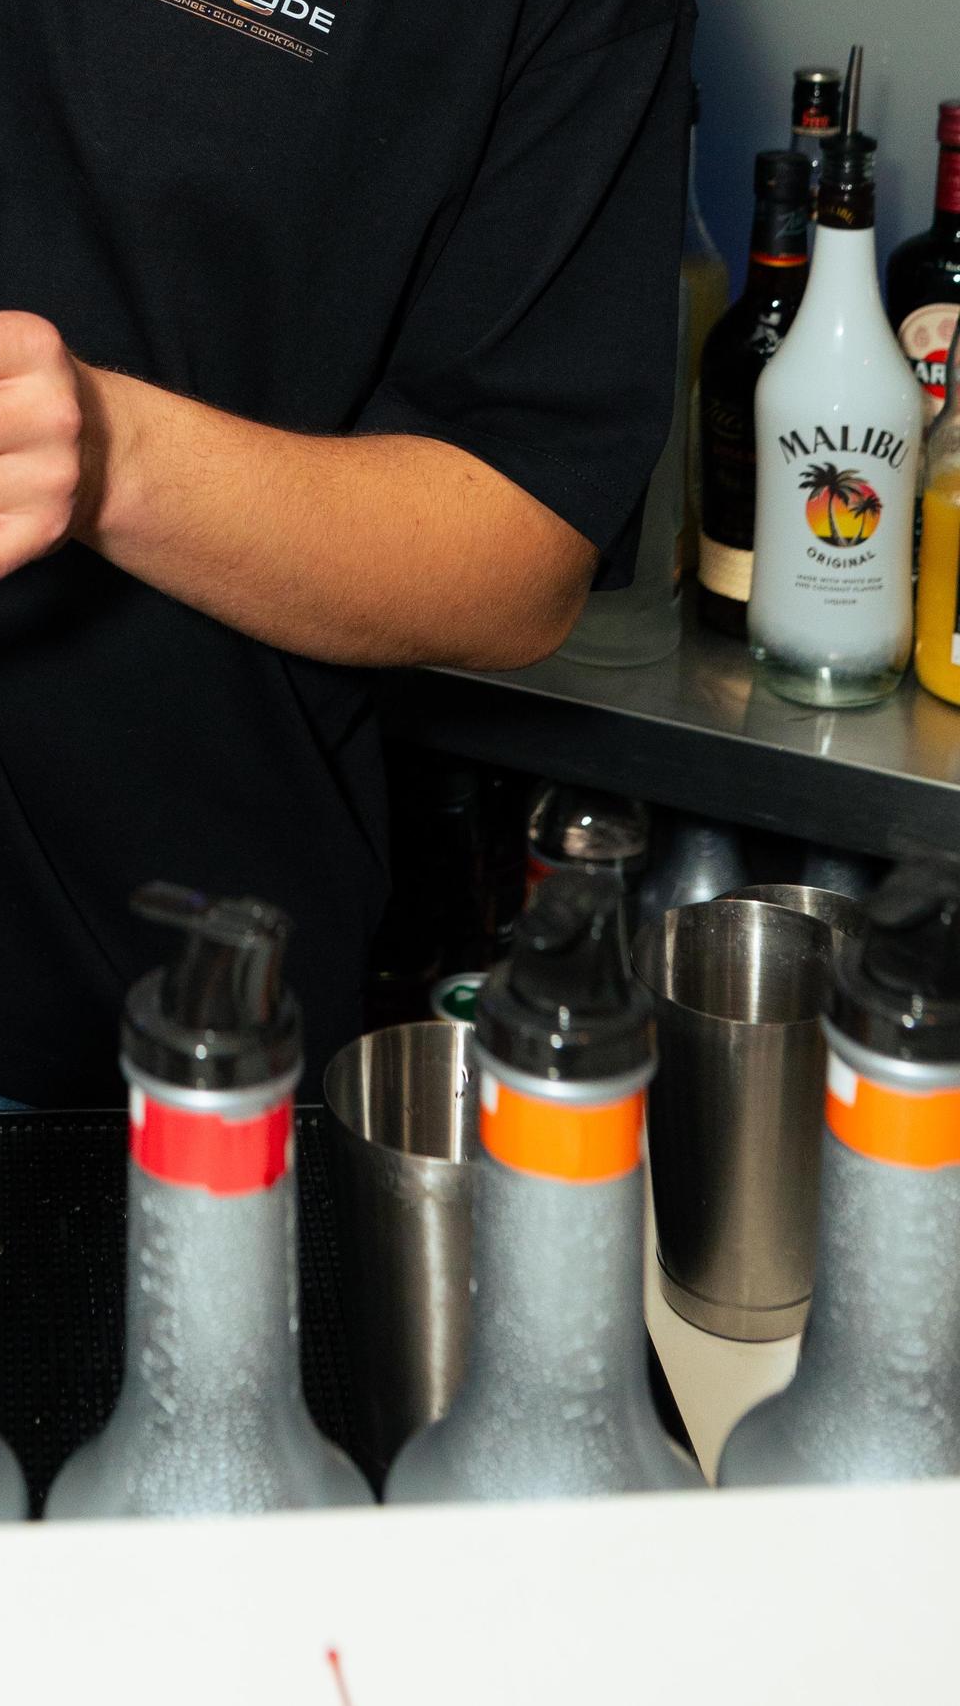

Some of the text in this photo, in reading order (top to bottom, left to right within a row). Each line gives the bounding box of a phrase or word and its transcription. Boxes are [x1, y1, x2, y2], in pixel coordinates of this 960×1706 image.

[212, 10, 245, 27] CLUB
[250, 24, 314, 58] COCKTAILS
[778, 425, 912, 470] MALIBU
[806, 546, 876, 569] ORIGINAL
